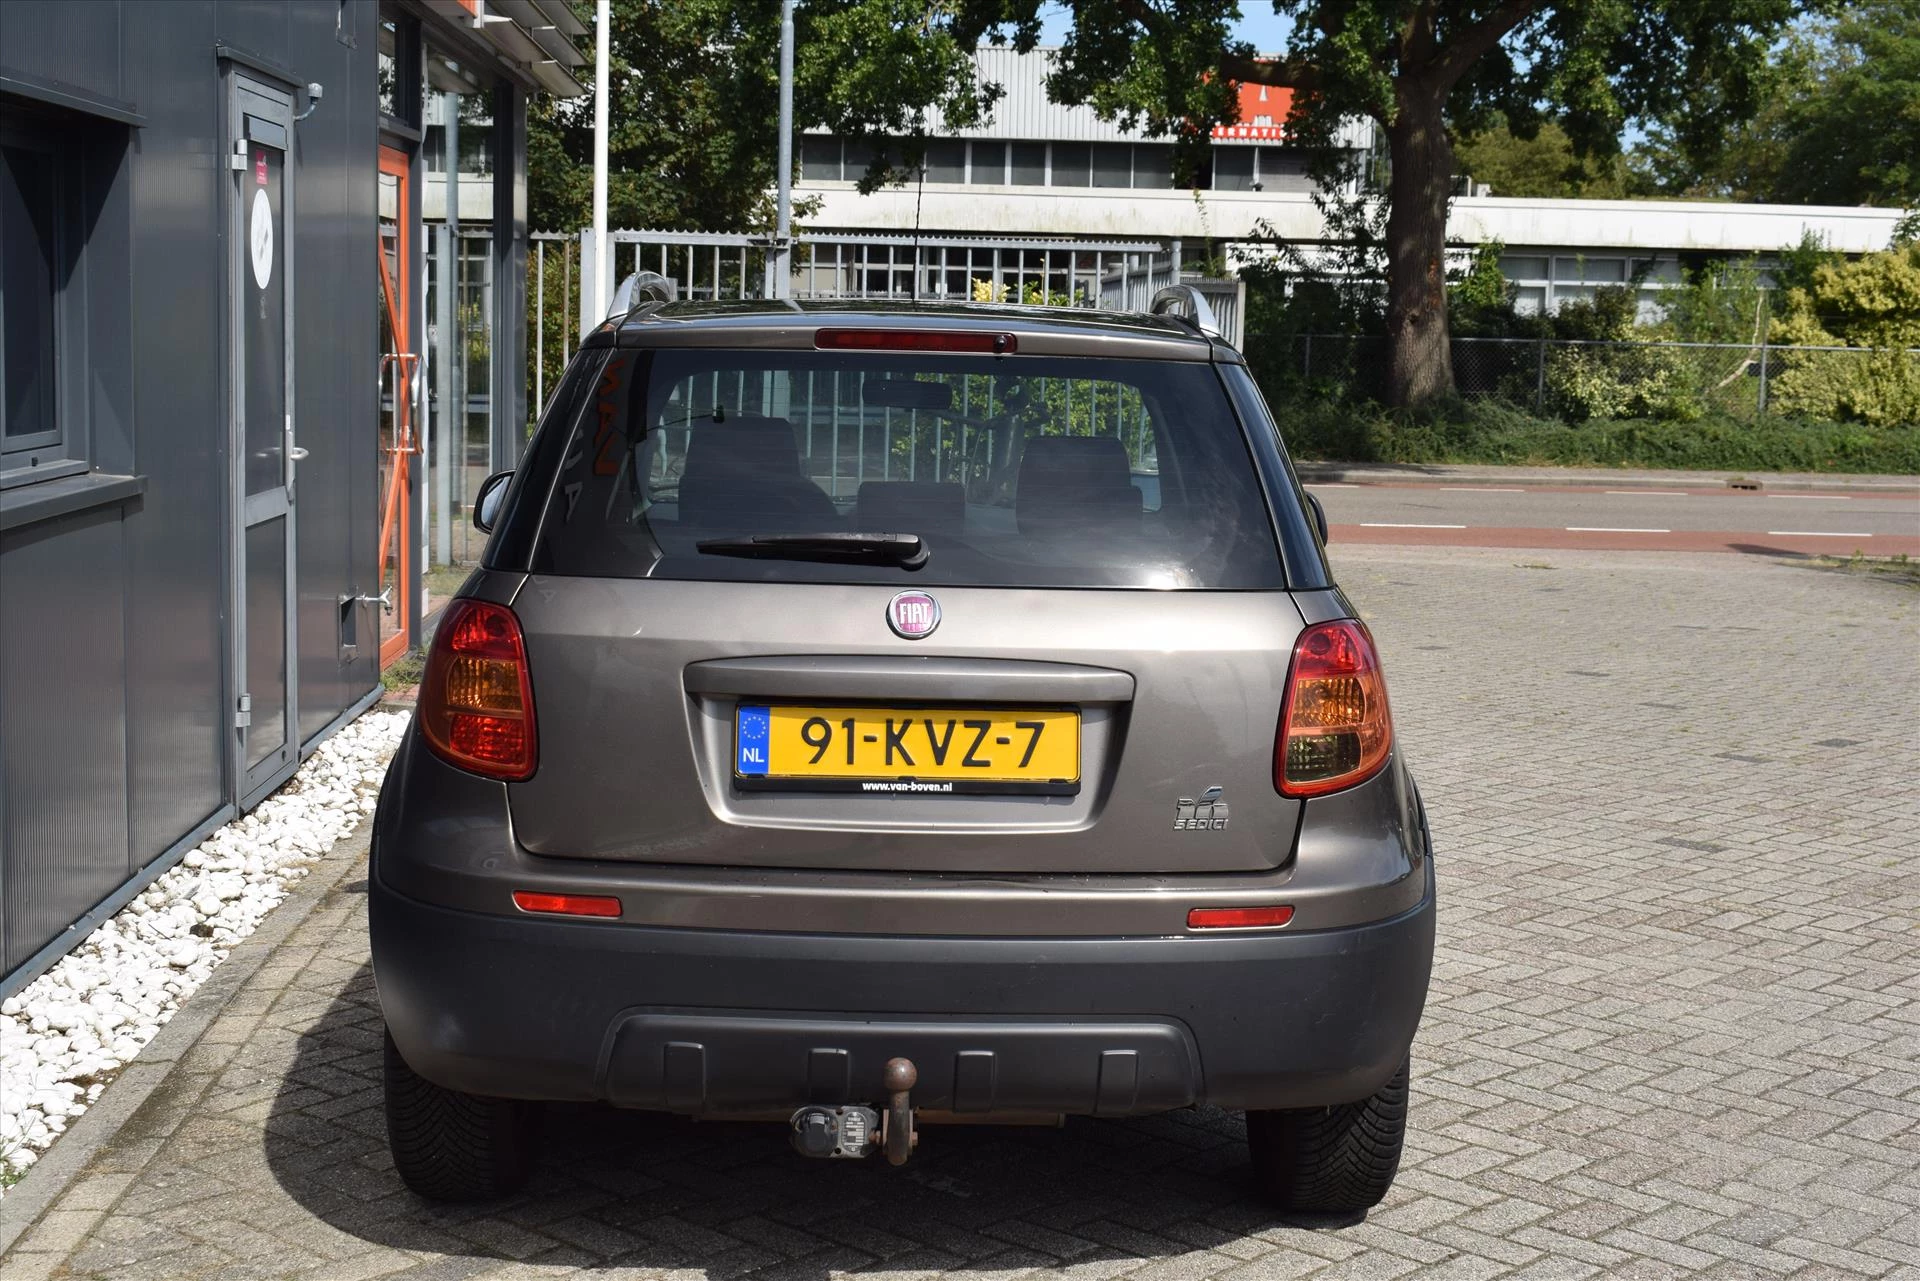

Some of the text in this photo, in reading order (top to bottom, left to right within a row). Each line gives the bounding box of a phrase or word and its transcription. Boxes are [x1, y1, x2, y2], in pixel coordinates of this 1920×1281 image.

[900, 602, 930, 624] FIAT
[801, 716, 1046, 768] 91-KVZ-7
[742, 747, 765, 763] NL
[862, 781, 953, 792] www.van-boven.nl
[1174, 818, 1229, 830] SEDICI
